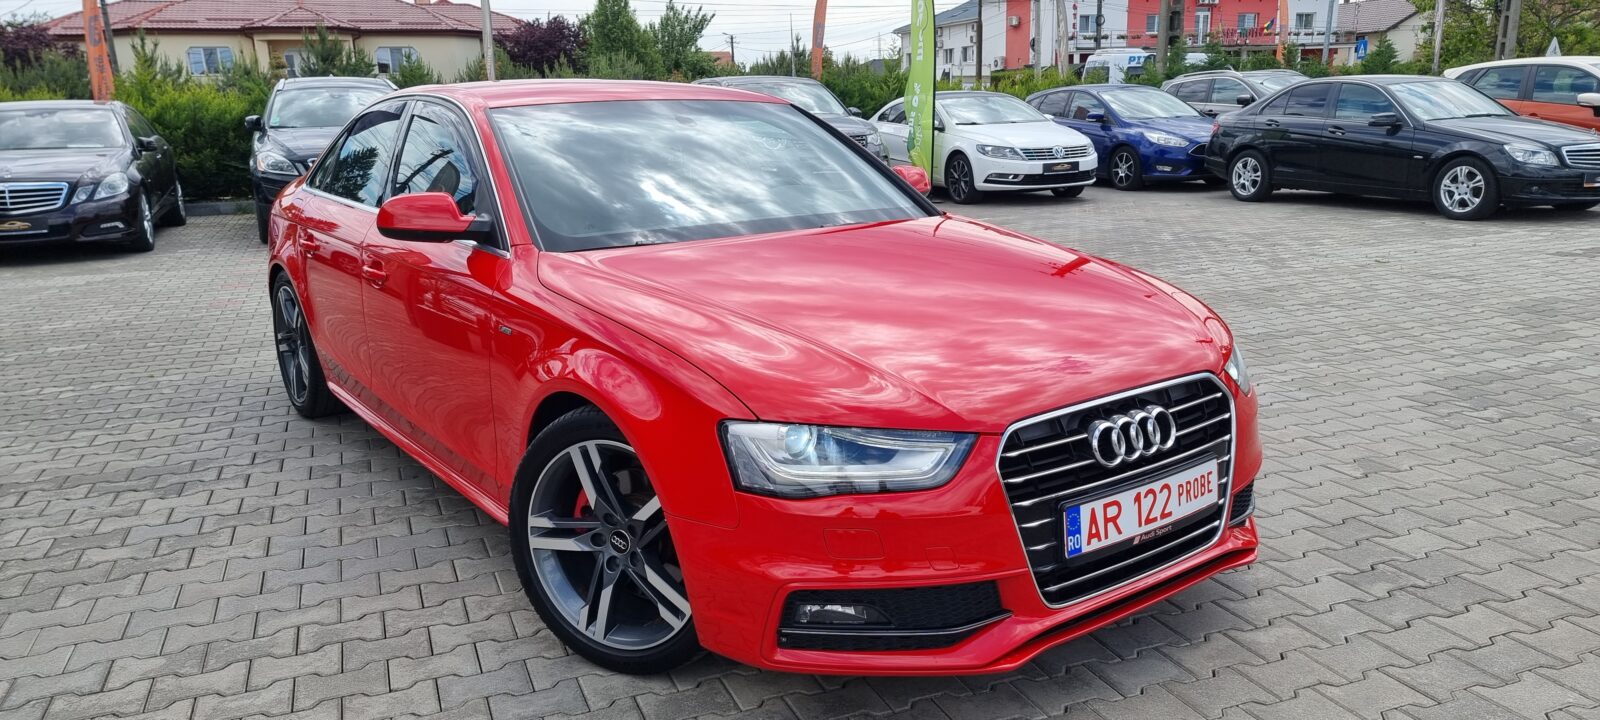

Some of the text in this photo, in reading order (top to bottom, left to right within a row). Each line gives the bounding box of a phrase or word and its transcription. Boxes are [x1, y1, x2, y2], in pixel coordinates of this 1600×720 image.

[1086, 470, 1213, 546] AR 122 PROBE
[1140, 525, 1173, 542] Audi Sport
[1067, 534, 1081, 552] RO
